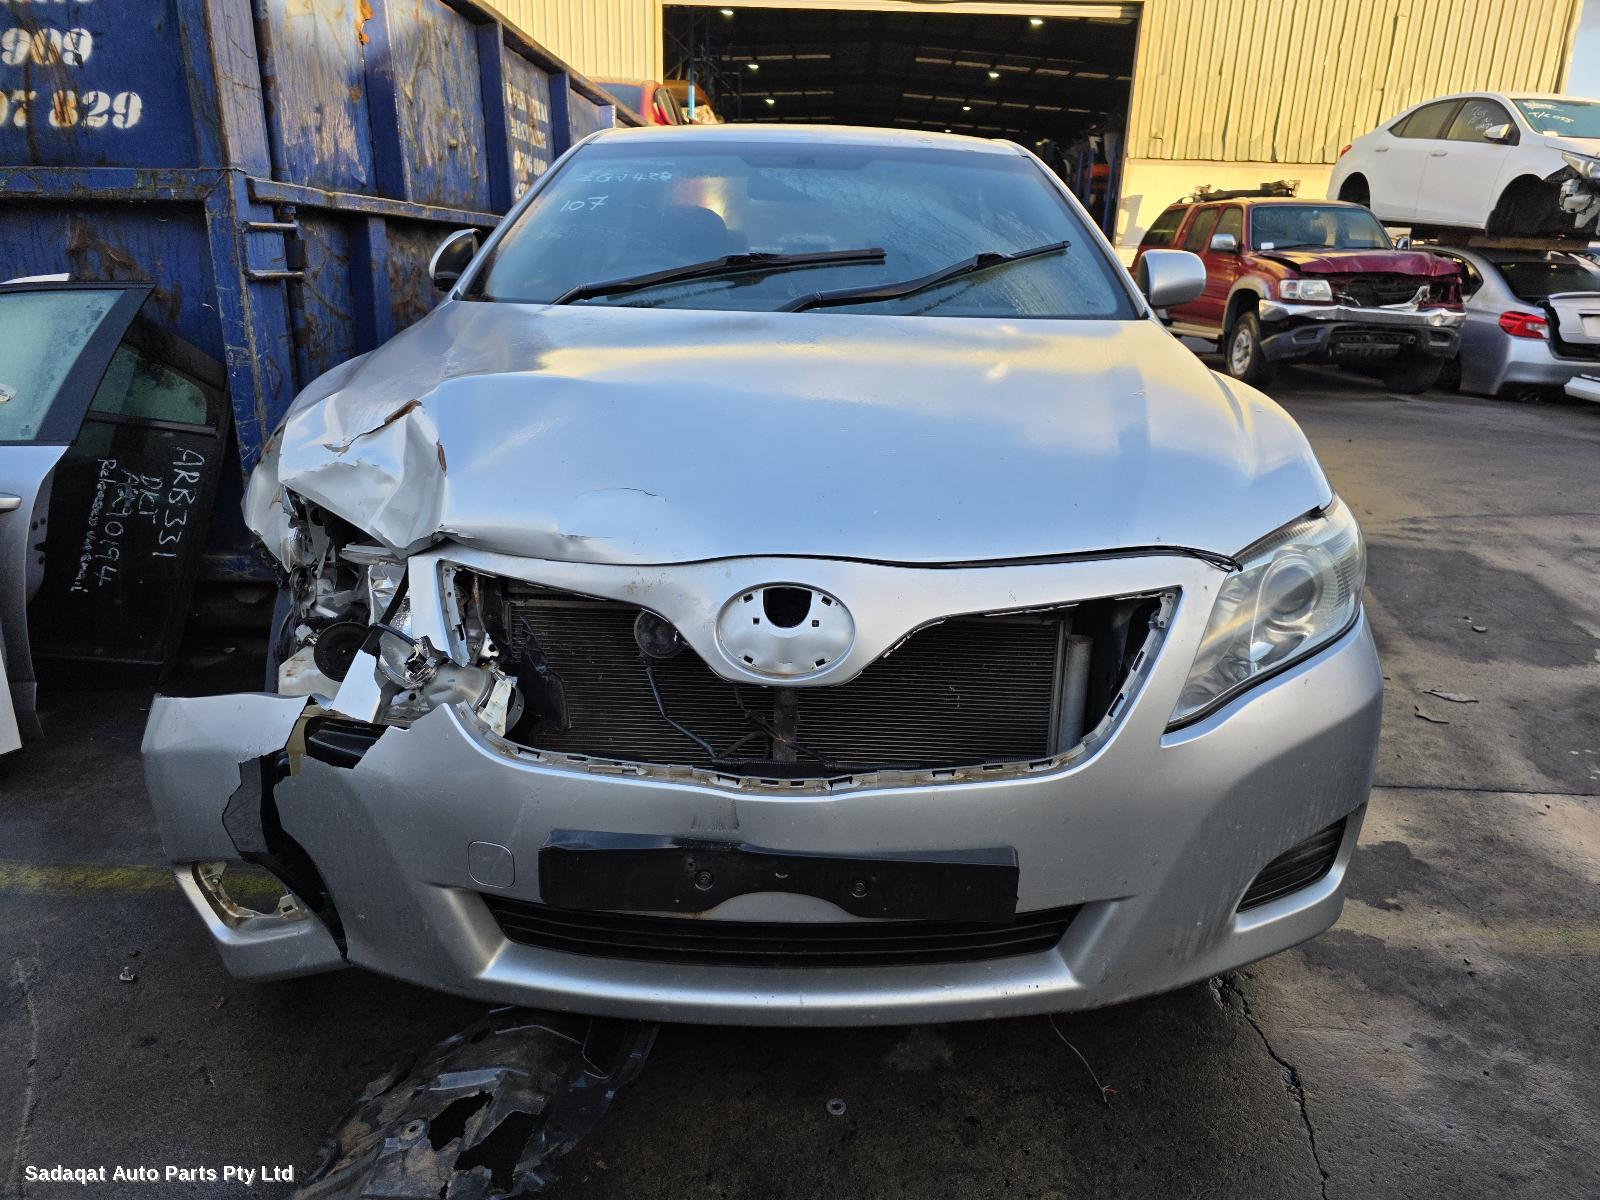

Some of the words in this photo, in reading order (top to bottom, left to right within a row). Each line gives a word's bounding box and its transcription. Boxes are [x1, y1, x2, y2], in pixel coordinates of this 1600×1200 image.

[1, 27, 94, 65] 909
[49, 90, 143, 128] 829
[560, 195, 609, 212] 107
